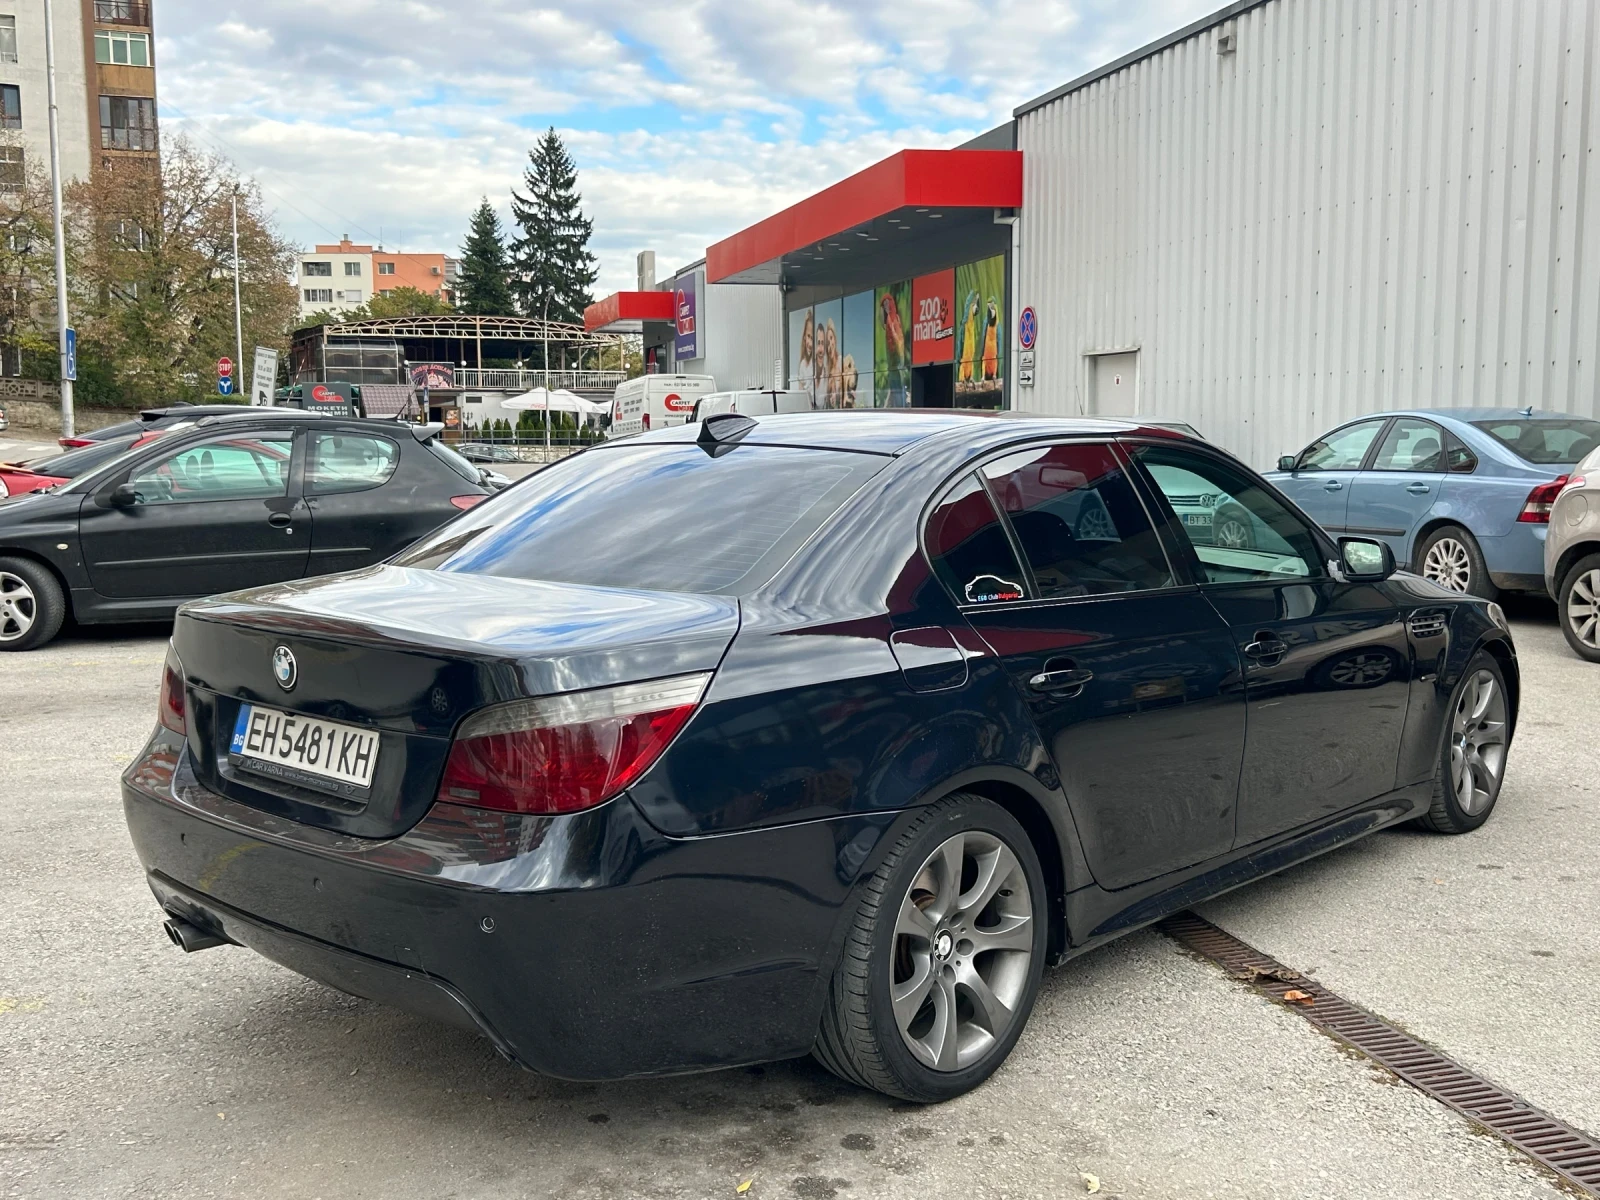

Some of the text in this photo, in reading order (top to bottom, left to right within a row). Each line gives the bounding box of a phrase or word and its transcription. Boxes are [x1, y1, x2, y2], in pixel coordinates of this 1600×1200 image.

[219, 363, 231, 372] STOP
[1189, 516, 1200, 525] BT
[233, 733, 244, 746] BG
[263, 763, 283, 777] VARNA
